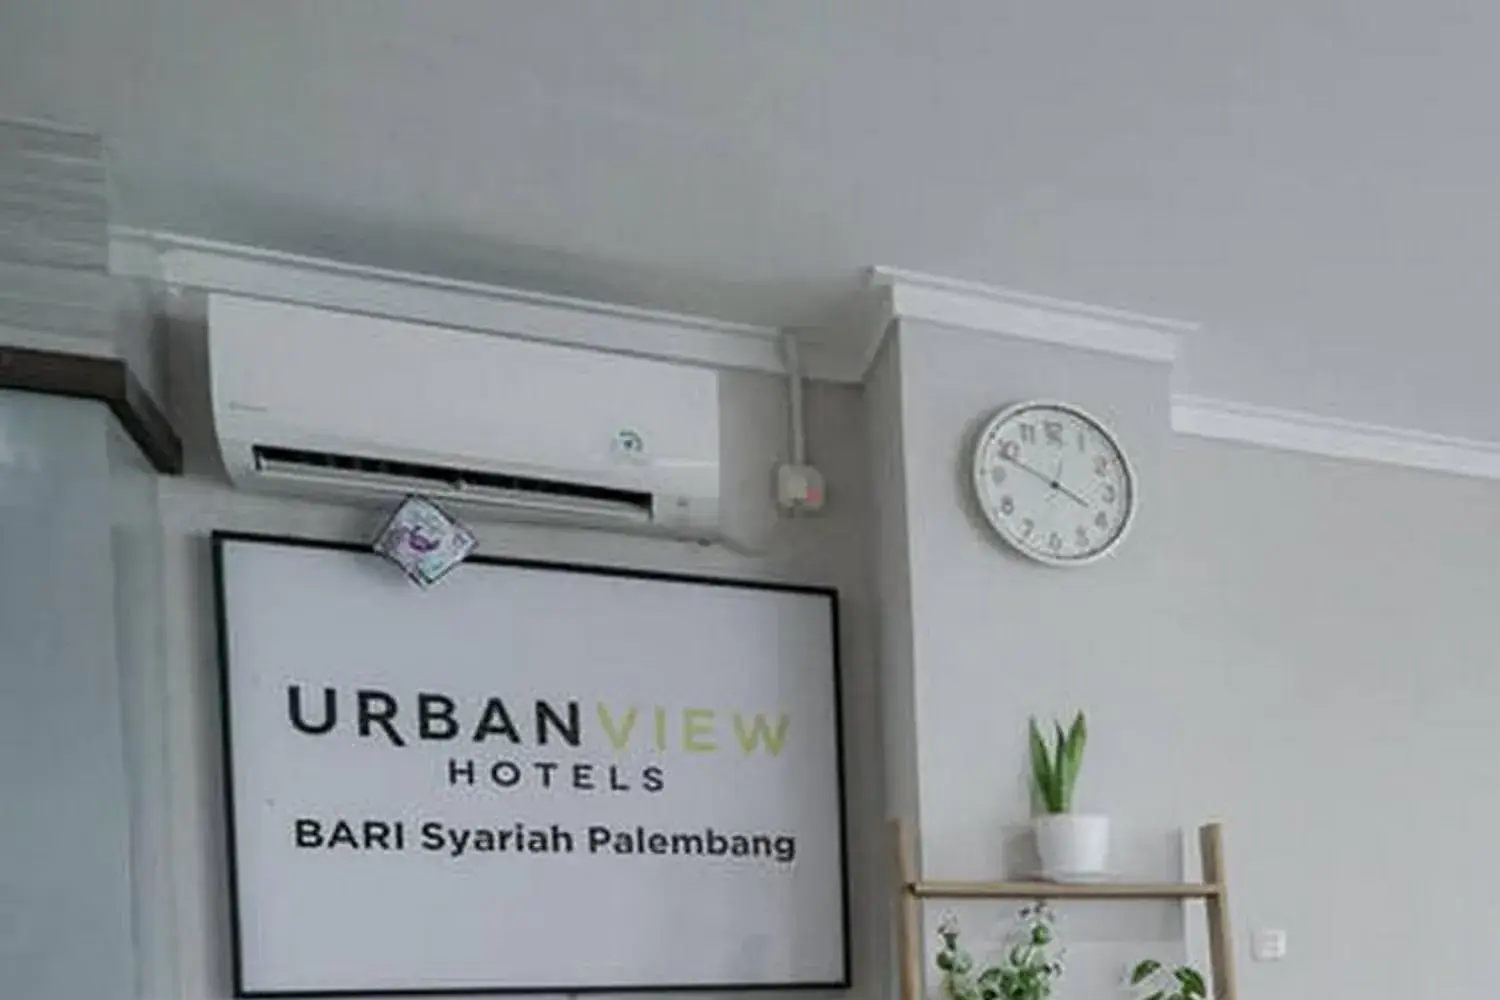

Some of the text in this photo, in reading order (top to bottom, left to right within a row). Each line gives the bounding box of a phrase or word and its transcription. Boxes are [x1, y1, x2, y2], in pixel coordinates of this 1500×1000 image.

[448, 758, 664, 793] HOTELS
[294, 818, 797, 863] BARI Syariah Palembang
